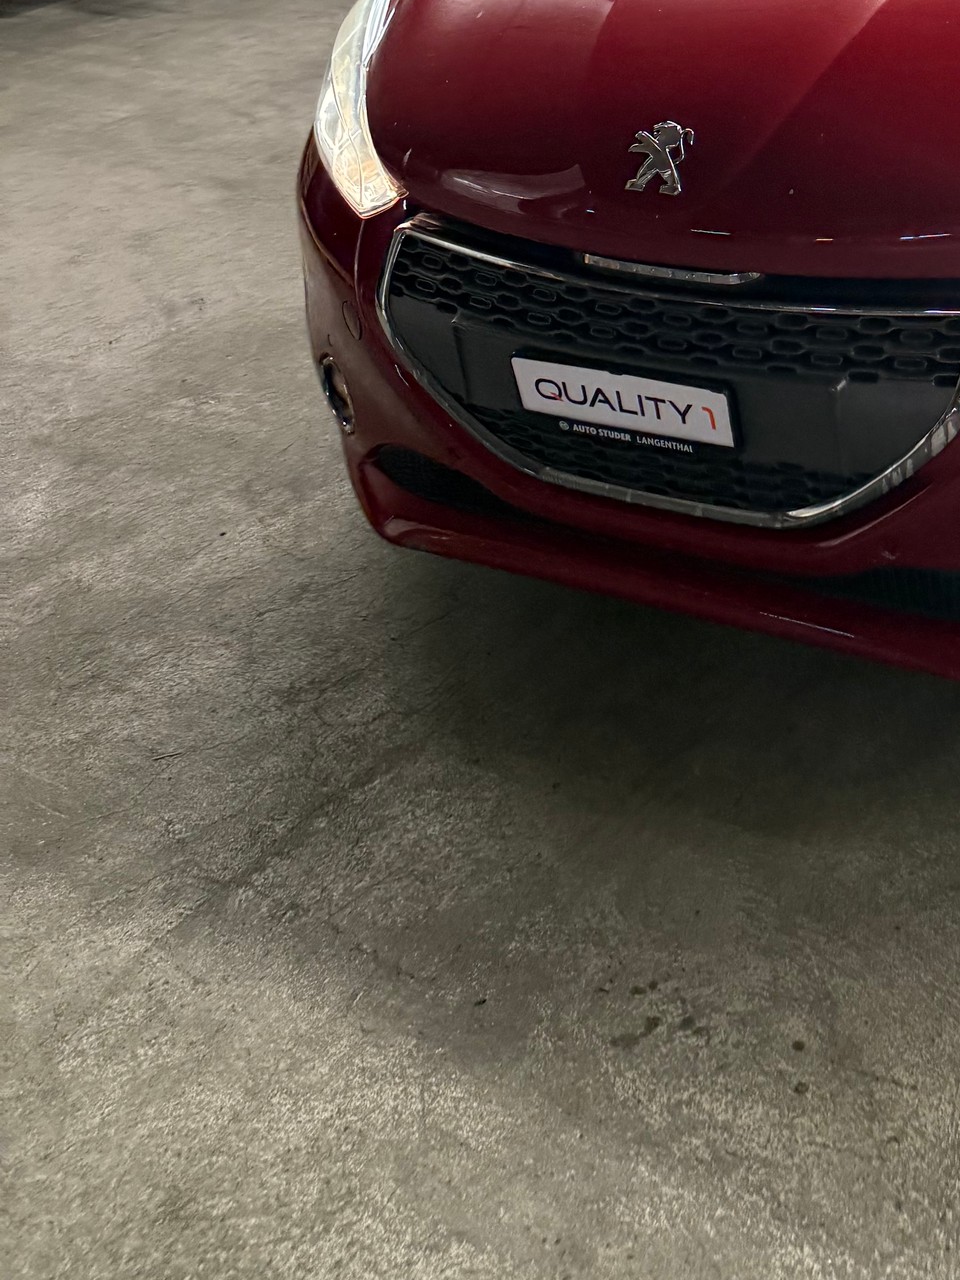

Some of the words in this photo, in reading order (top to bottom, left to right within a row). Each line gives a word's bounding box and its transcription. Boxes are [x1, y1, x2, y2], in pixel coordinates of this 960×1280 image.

[534, 378, 693, 425] QUALITY
[701, 406, 717, 431] 1
[572, 423, 597, 435] AUTO
[598, 426, 632, 442] STUDER
[636, 435, 694, 453] LANGENTHAL
